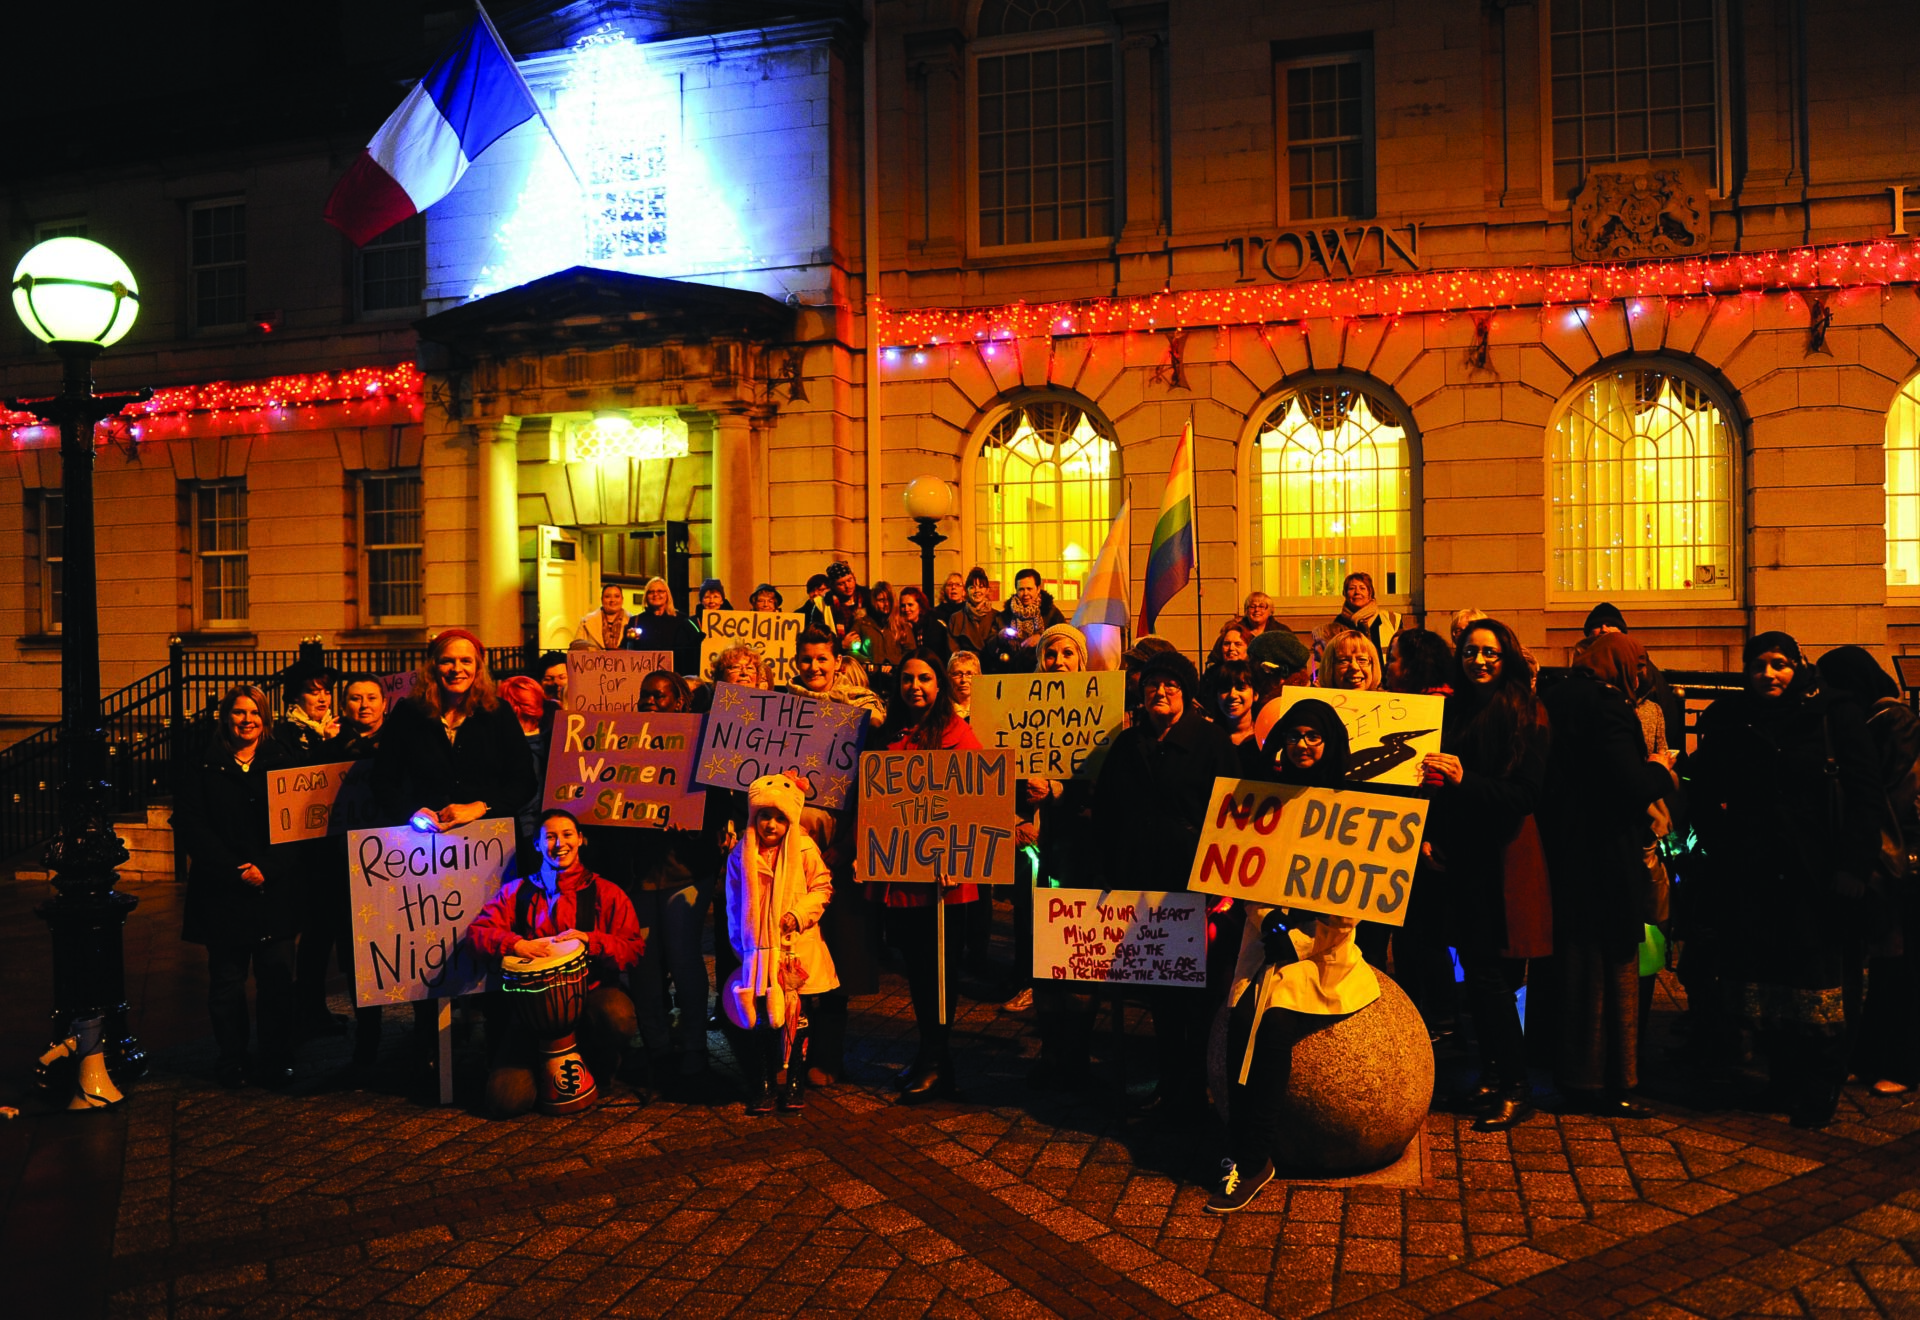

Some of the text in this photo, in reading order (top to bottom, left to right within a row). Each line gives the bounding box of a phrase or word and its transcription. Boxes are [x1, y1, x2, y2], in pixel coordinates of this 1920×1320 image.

[1223, 222, 1425, 283] TOWN
[707, 612, 800, 641] Reclaim
[571, 653, 626, 674] Women
[383, 674, 403, 692] We
[599, 674, 627, 695] for
[995, 676, 1100, 702] I AM A
[750, 695, 817, 729] THE
[1007, 705, 1104, 730] WOMAN
[563, 714, 685, 753] Rotherham
[711, 721, 810, 758] NIGHT
[995, 729, 1111, 749] I BELONG
[277, 776, 287, 795] I
[292, 770, 329, 792] AM
[578, 756, 676, 786] Women
[866, 752, 1007, 798] RECLAIM
[279, 807, 291, 831] I
[555, 783, 671, 828] are Strong
[892, 795, 949, 825] THE
[1216, 792, 1422, 854] NO DIETS
[359, 832, 504, 887] Reclaim
[868, 824, 1013, 878] NIGHT
[1199, 843, 1410, 914] NO RIOTS
[398, 884, 465, 932] the
[1148, 906, 1196, 923] HEART
[1136, 925, 1169, 941] SOUL
[1072, 943, 1107, 958] INTO
[1144, 943, 1166, 956] THE
[1123, 957, 1148, 969] ACT
[1152, 959, 1172, 971] WE
[1174, 956, 1198, 971] ARE
[1132, 969, 1154, 980] THE
